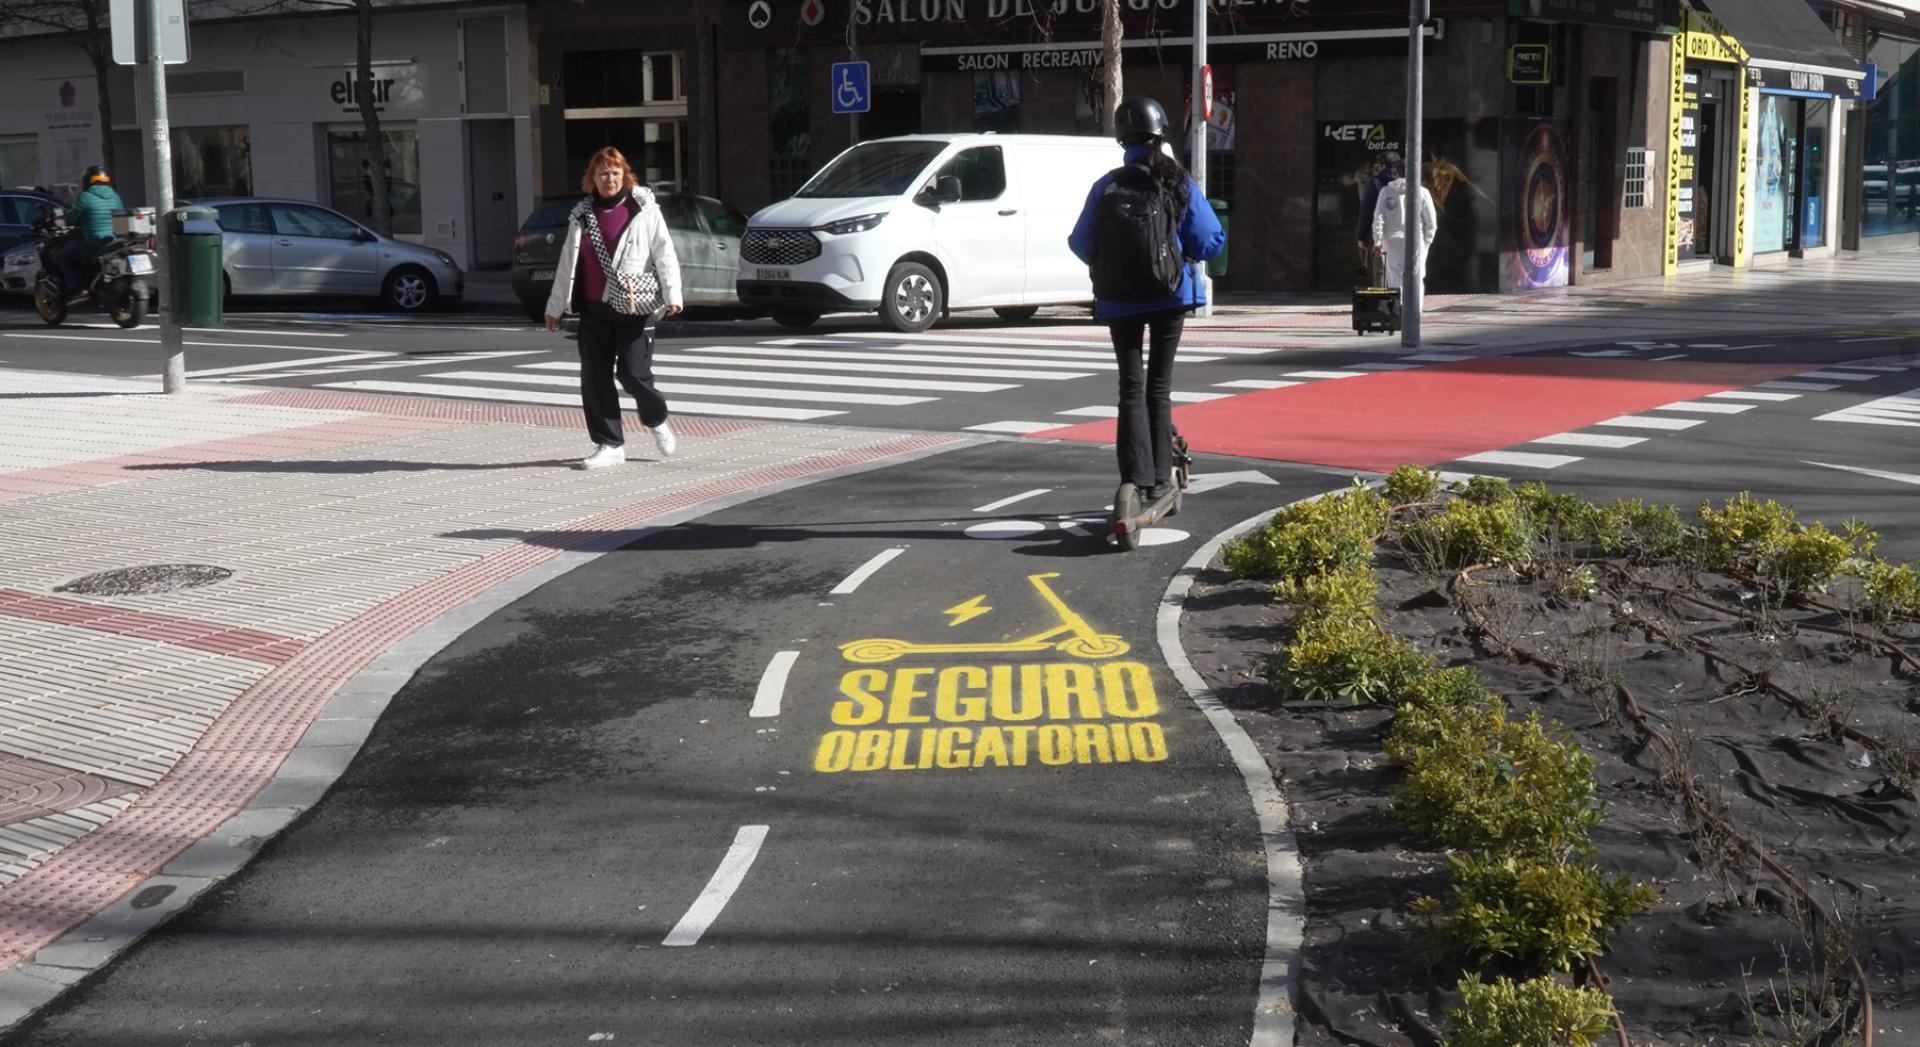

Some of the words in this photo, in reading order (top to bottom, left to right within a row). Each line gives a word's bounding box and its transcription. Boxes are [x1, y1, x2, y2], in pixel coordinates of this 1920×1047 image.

[957, 53, 1009, 70] SALON
[1266, 41, 1318, 60] RENO
[1691, 37, 1708, 55] ORO
[1711, 41, 1716, 56] Y
[1672, 113, 1680, 140] AL
[1667, 147, 1679, 264] EFECTIVO
[1737, 183, 1746, 254] CASA
[831, 662, 1160, 726] SEGURO
[814, 722, 1168, 773] OBLIGATORIO
